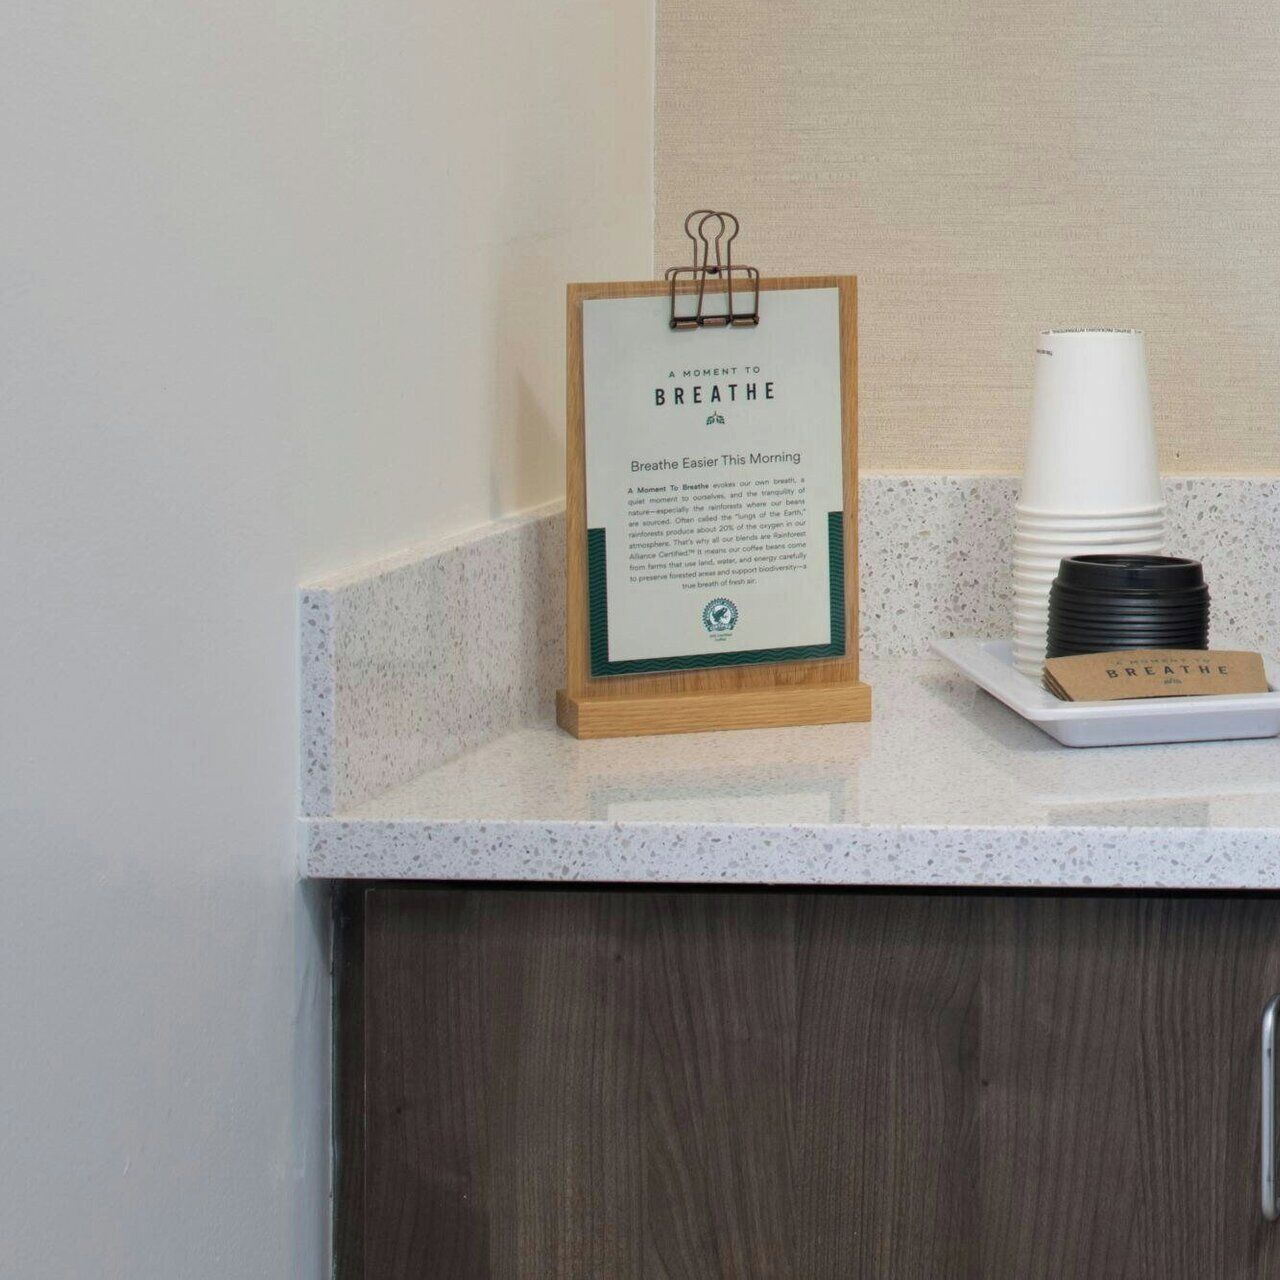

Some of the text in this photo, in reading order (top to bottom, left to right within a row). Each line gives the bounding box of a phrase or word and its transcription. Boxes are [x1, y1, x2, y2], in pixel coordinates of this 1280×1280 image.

[683, 367, 737, 377] MOMENT
[745, 366, 760, 374] TO
[655, 382, 774, 406] BREATHE
[631, 452, 801, 472] Breathe Easier This Morning
[637, 486, 666, 494] Moment
[682, 483, 709, 491] Breathe
[761, 488, 795, 497] tranquility
[708, 503, 742, 511] rainforests
[698, 515, 718, 523] called
[629, 530, 663, 538] rainforests
[666, 528, 694, 536] produce
[639, 575, 667, 583] preserve
[669, 571, 696, 579] forested
[732, 567, 757, 575] support
[1106, 665, 1228, 679] BREATHE
